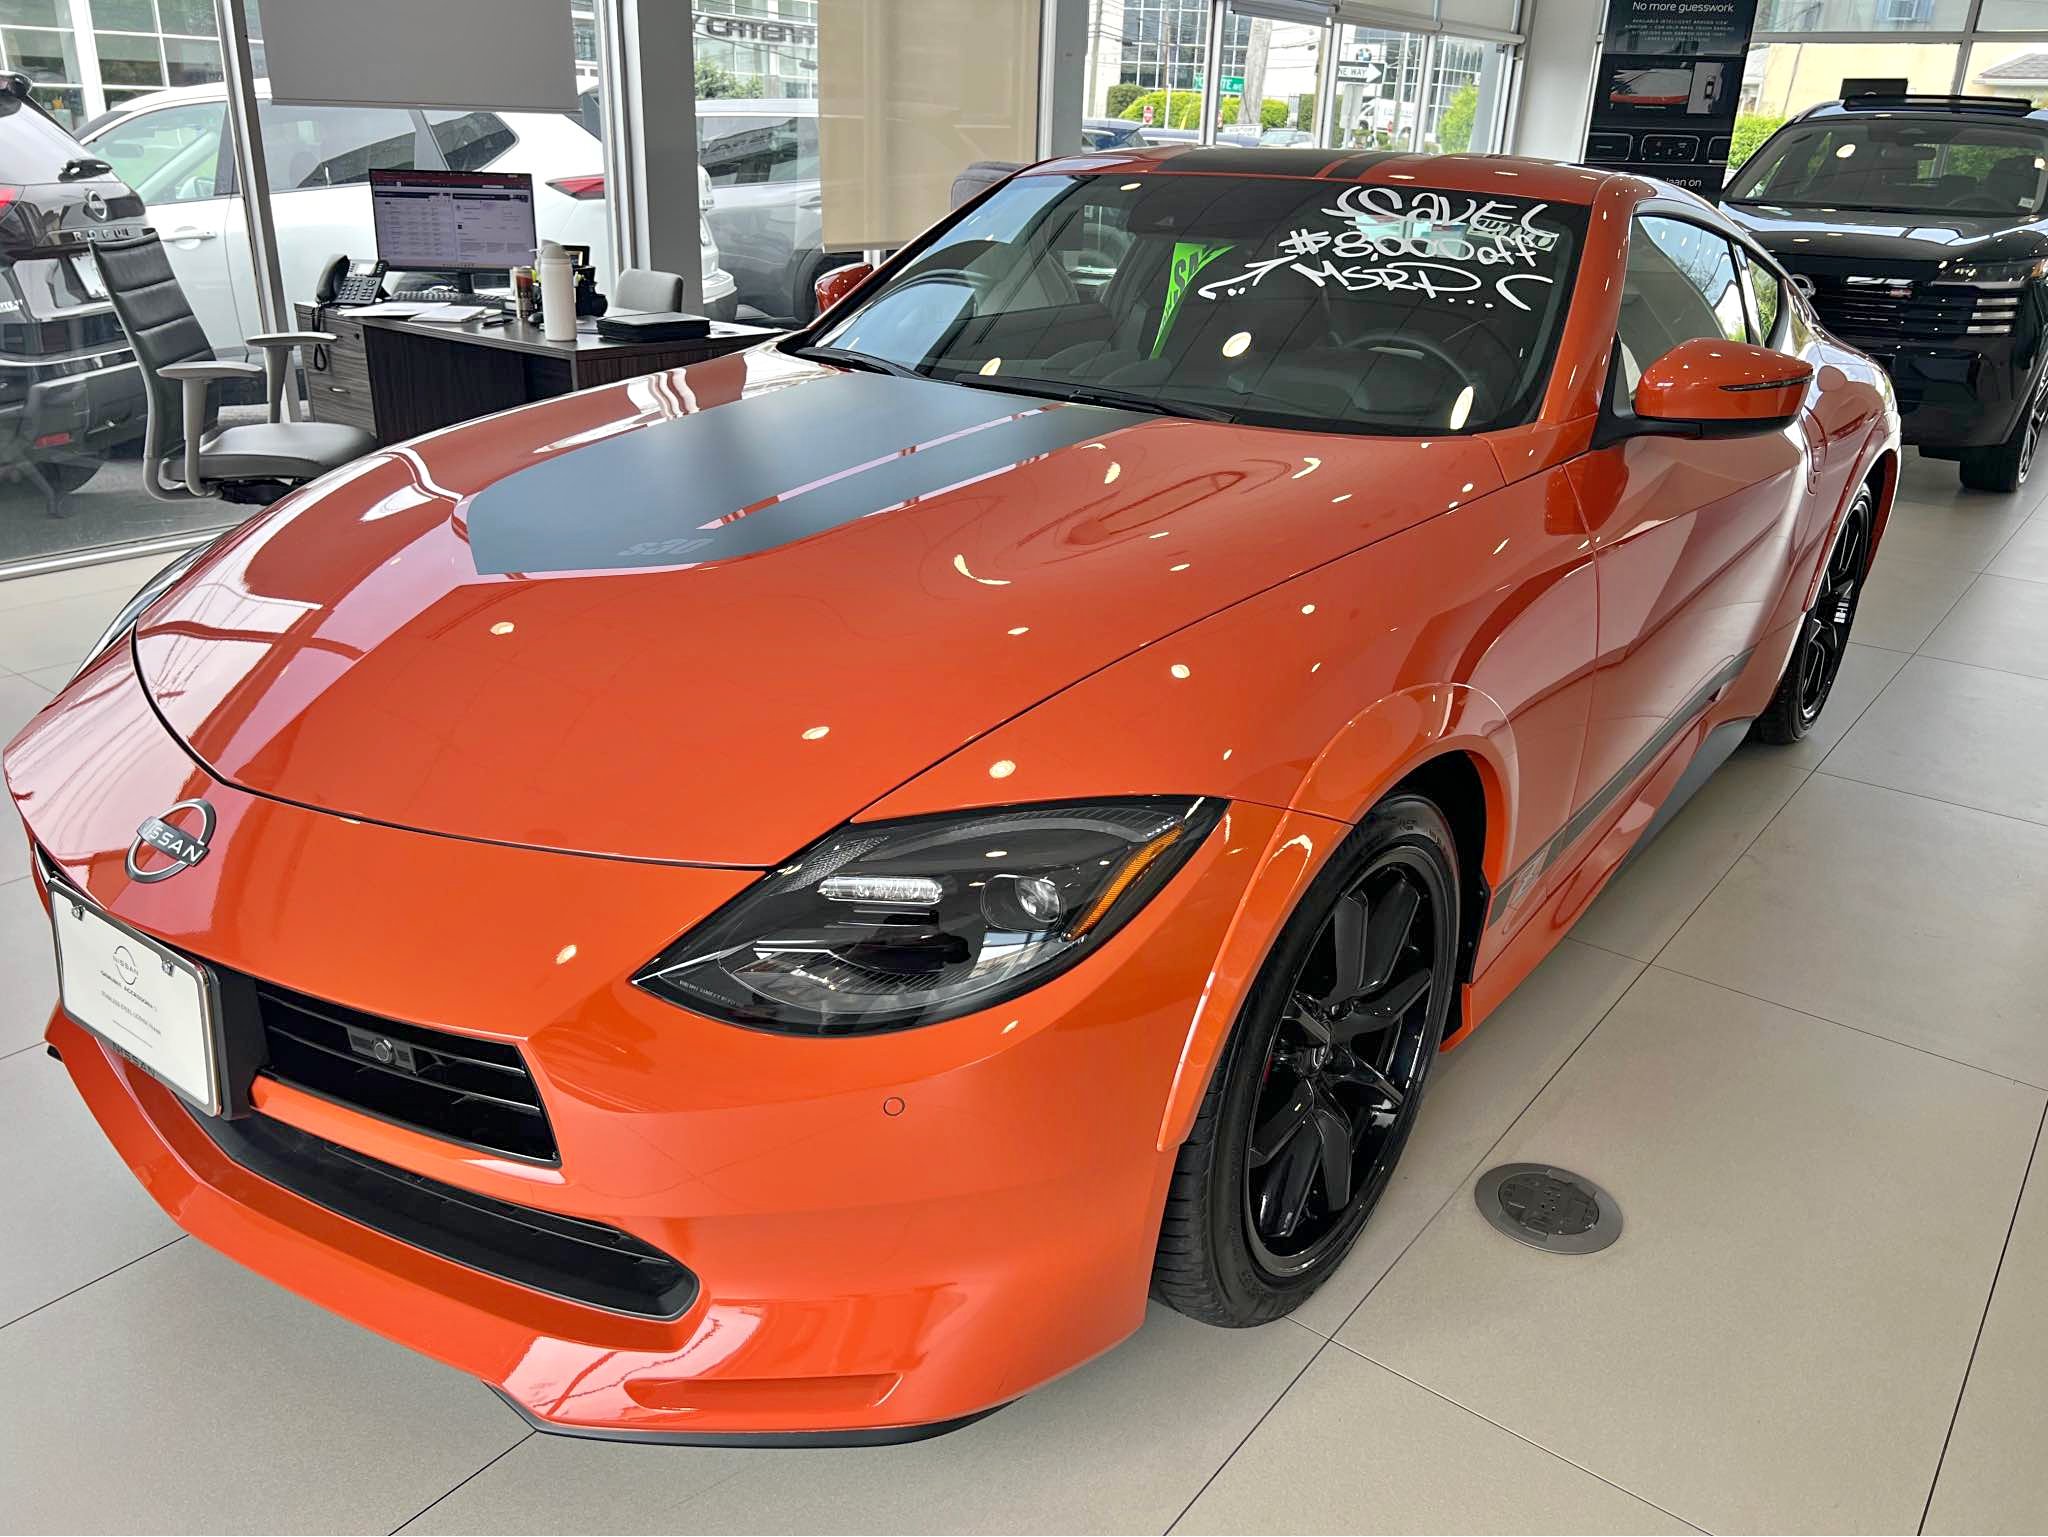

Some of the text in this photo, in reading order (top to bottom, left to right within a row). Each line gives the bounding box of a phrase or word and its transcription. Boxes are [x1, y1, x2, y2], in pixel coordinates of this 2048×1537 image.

[1632, 2, 1734, 13] No more guesswork
[1350, 67, 1367, 77] WAY
[1477, 235, 1537, 267] off
